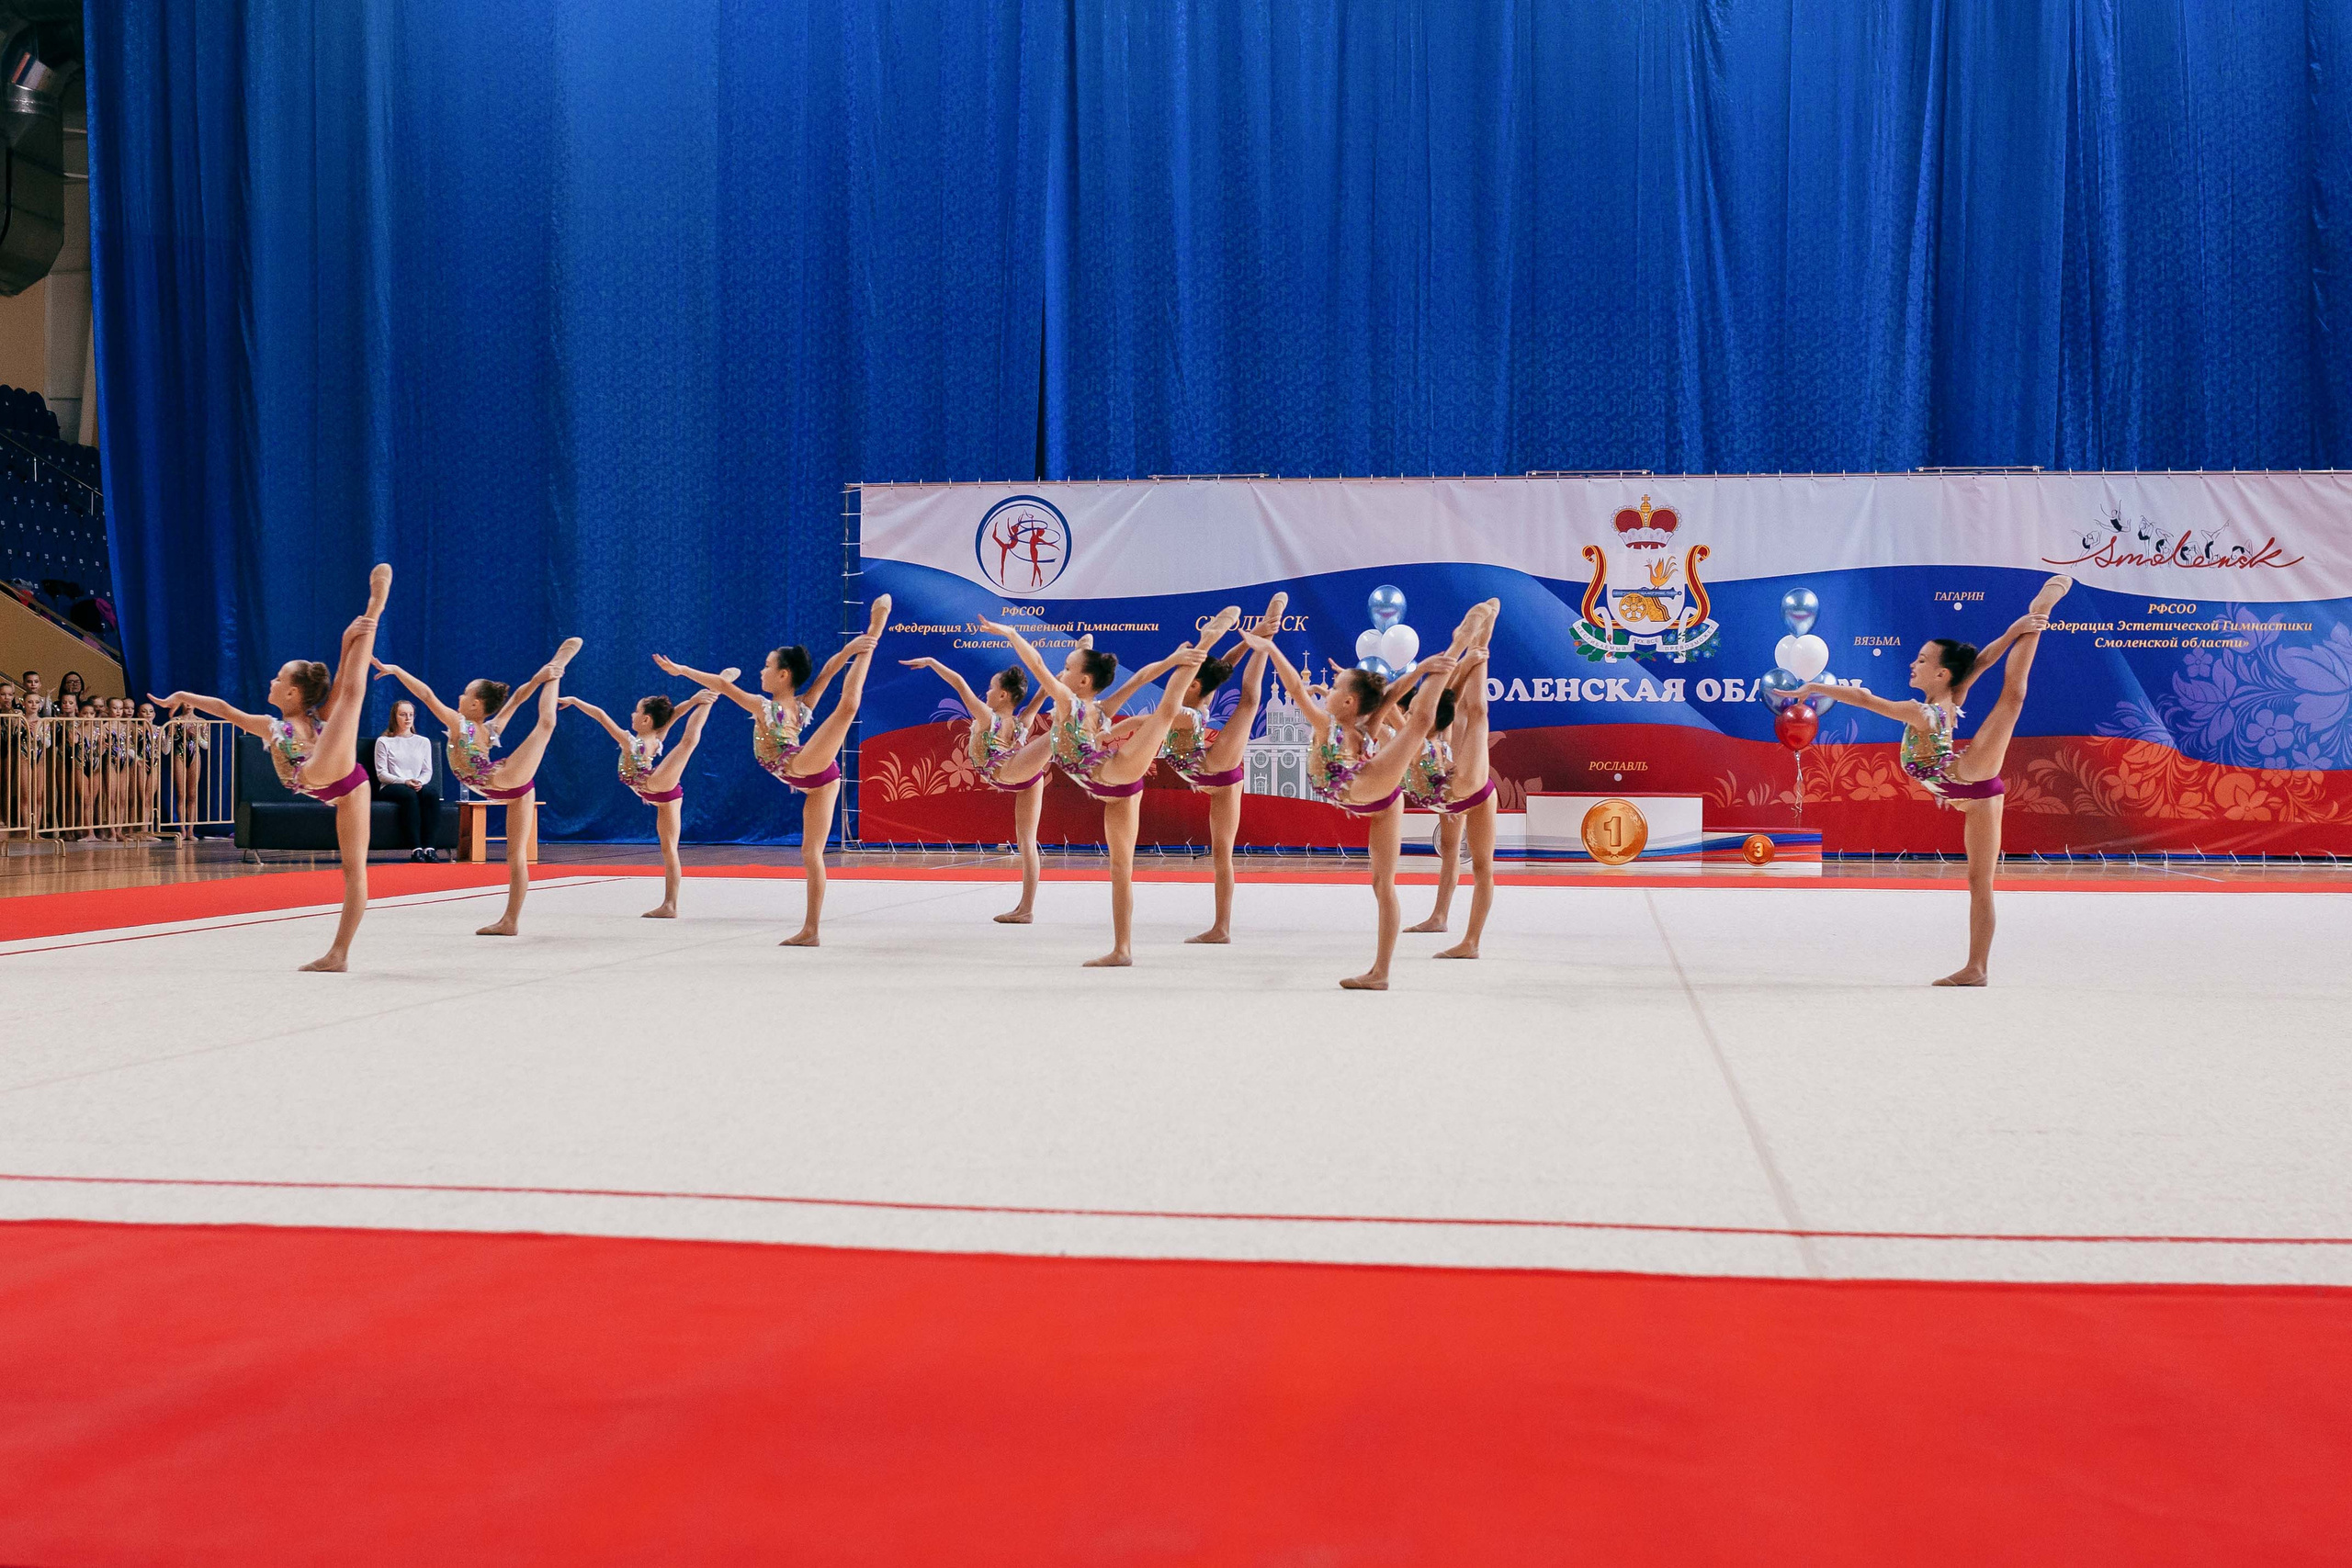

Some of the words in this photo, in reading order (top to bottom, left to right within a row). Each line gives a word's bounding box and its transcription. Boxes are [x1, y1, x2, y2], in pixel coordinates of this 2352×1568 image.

[2041, 529, 2304, 568] Smolensk
[1934, 592, 1985, 601] ГАГАРИН
[1001, 605, 1045, 616] РФСОО
[2147, 603, 2197, 615] РФСОО
[888, 622, 961, 635] «Федерация
[965, 621, 1074, 636] Хуственной
[1076, 621, 1159, 632] Гимнастики
[2117, 620, 2219, 631] Эстетической
[2222, 620, 2312, 632] Гимнастики
[953, 637, 1028, 649] Смоленск
[1031, 637, 1080, 649] област
[1853, 636, 1901, 646] ВЯЗЬМА
[2094, 637, 2178, 649] Смоленской
[2181, 637, 2249, 649] области»
[1485, 678, 1686, 702] ОЛЕНСКАЯ
[1589, 761, 1648, 771] РОСЛАВЛЬ
[1603, 816, 1622, 847] 1
[1753, 841, 1764, 858] 3
